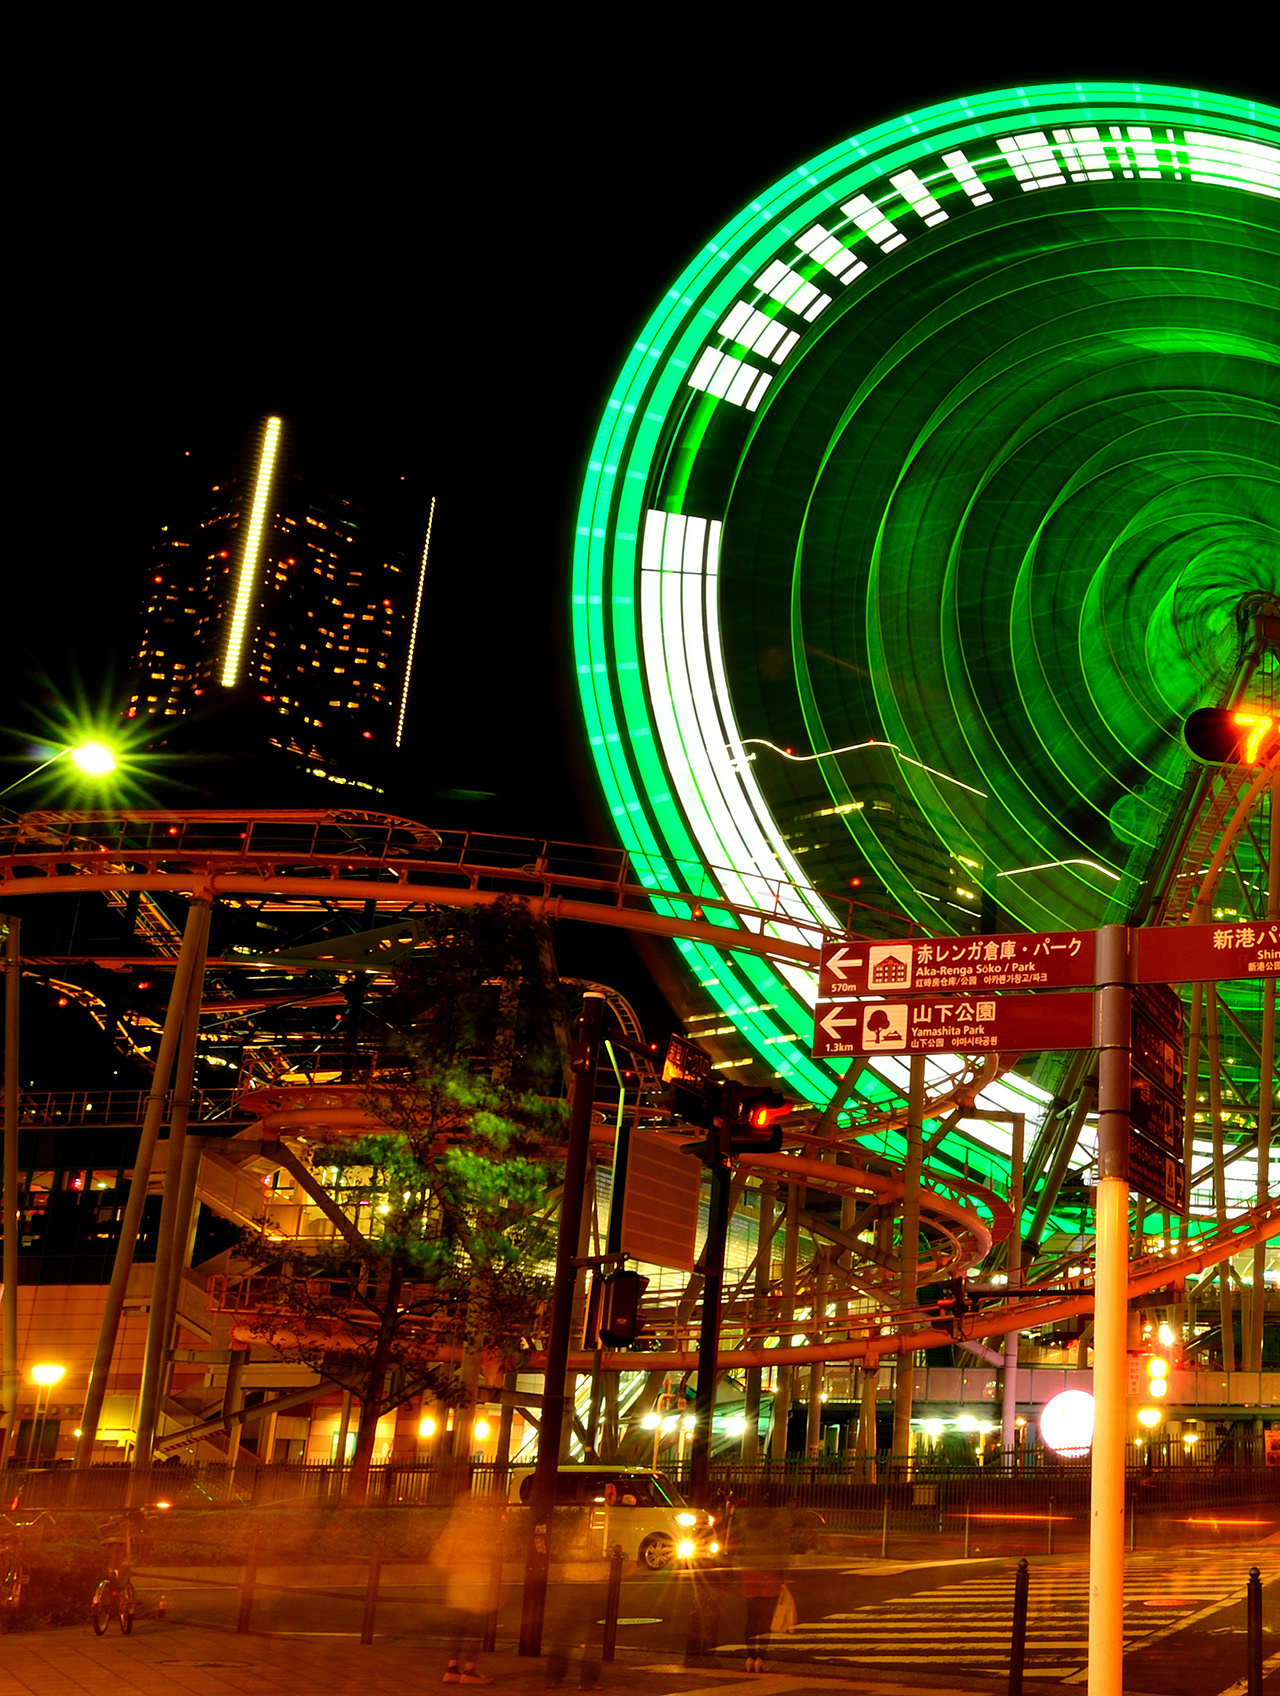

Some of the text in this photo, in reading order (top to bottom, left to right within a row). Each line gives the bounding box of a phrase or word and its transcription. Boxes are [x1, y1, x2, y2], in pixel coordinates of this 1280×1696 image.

[917, 937, 1082, 965] 赤レンガ倉庫・パーク
[916, 965, 973, 978] Aka-Renga
[1012, 961, 1036, 972] Park
[831, 983, 857, 992] 570m
[913, 1001, 996, 1024] 山下公園
[911, 1025, 985, 1037] Yamashita Park
[825, 1042, 854, 1052] 1.3km
